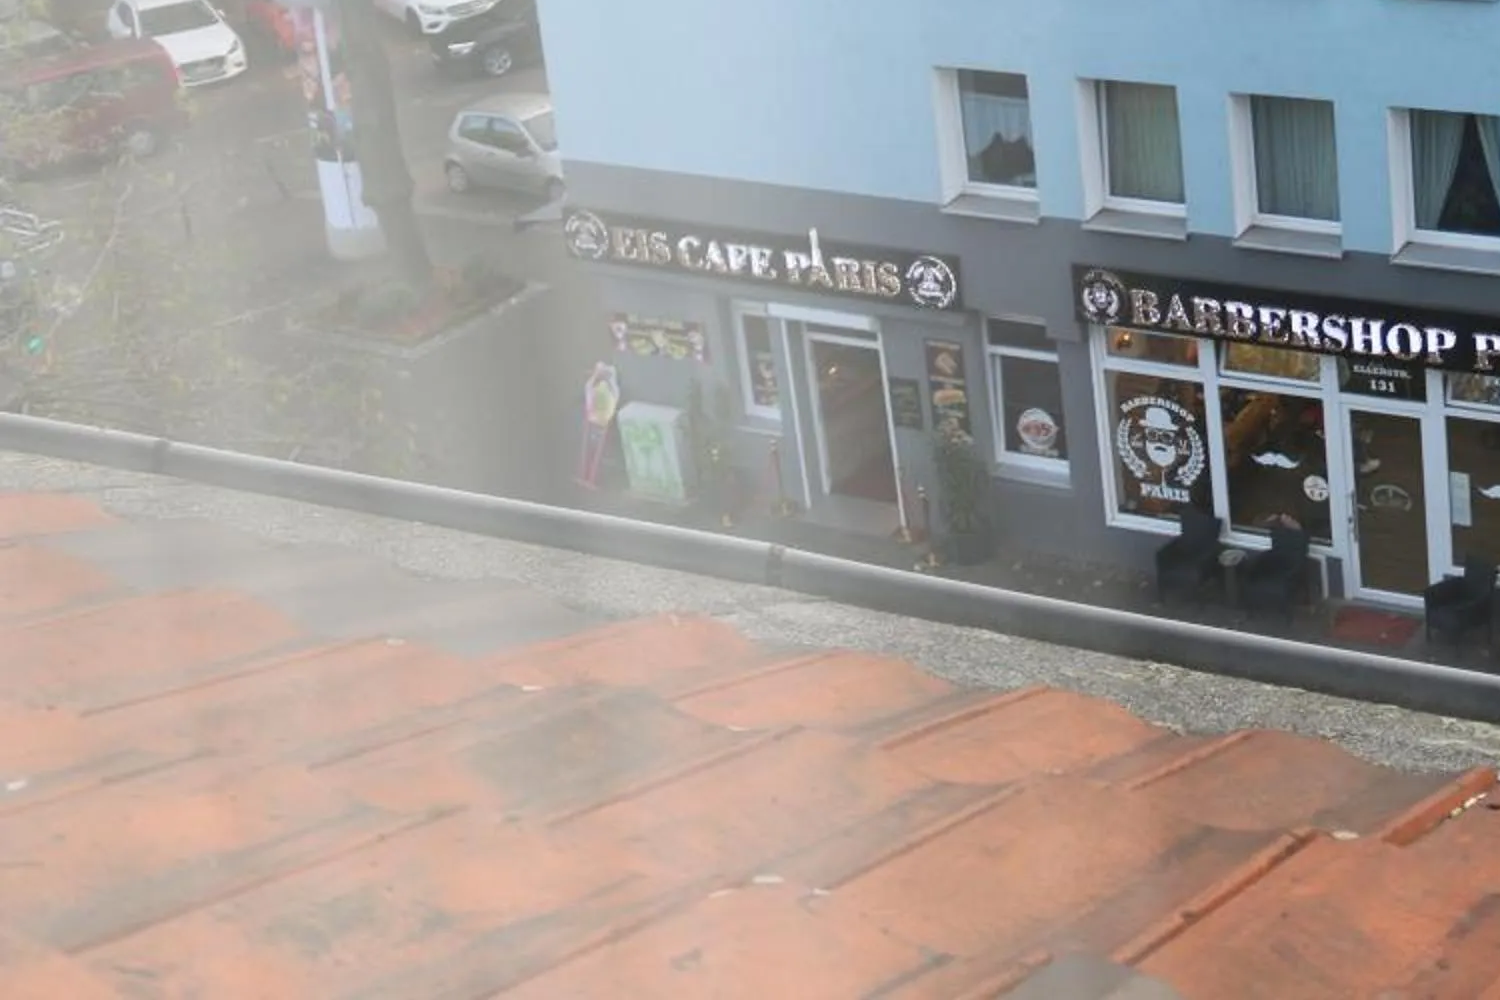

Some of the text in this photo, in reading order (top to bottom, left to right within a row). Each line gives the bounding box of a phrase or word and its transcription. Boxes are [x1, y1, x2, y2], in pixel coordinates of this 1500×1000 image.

[611, 226, 671, 265] EIS
[783, 227, 901, 297] PARIS
[1130, 288, 1457, 365] BARBERSHOP
[1120, 396, 1195, 422] BARBERSHOP
[1140, 478, 1191, 503] PARIS
